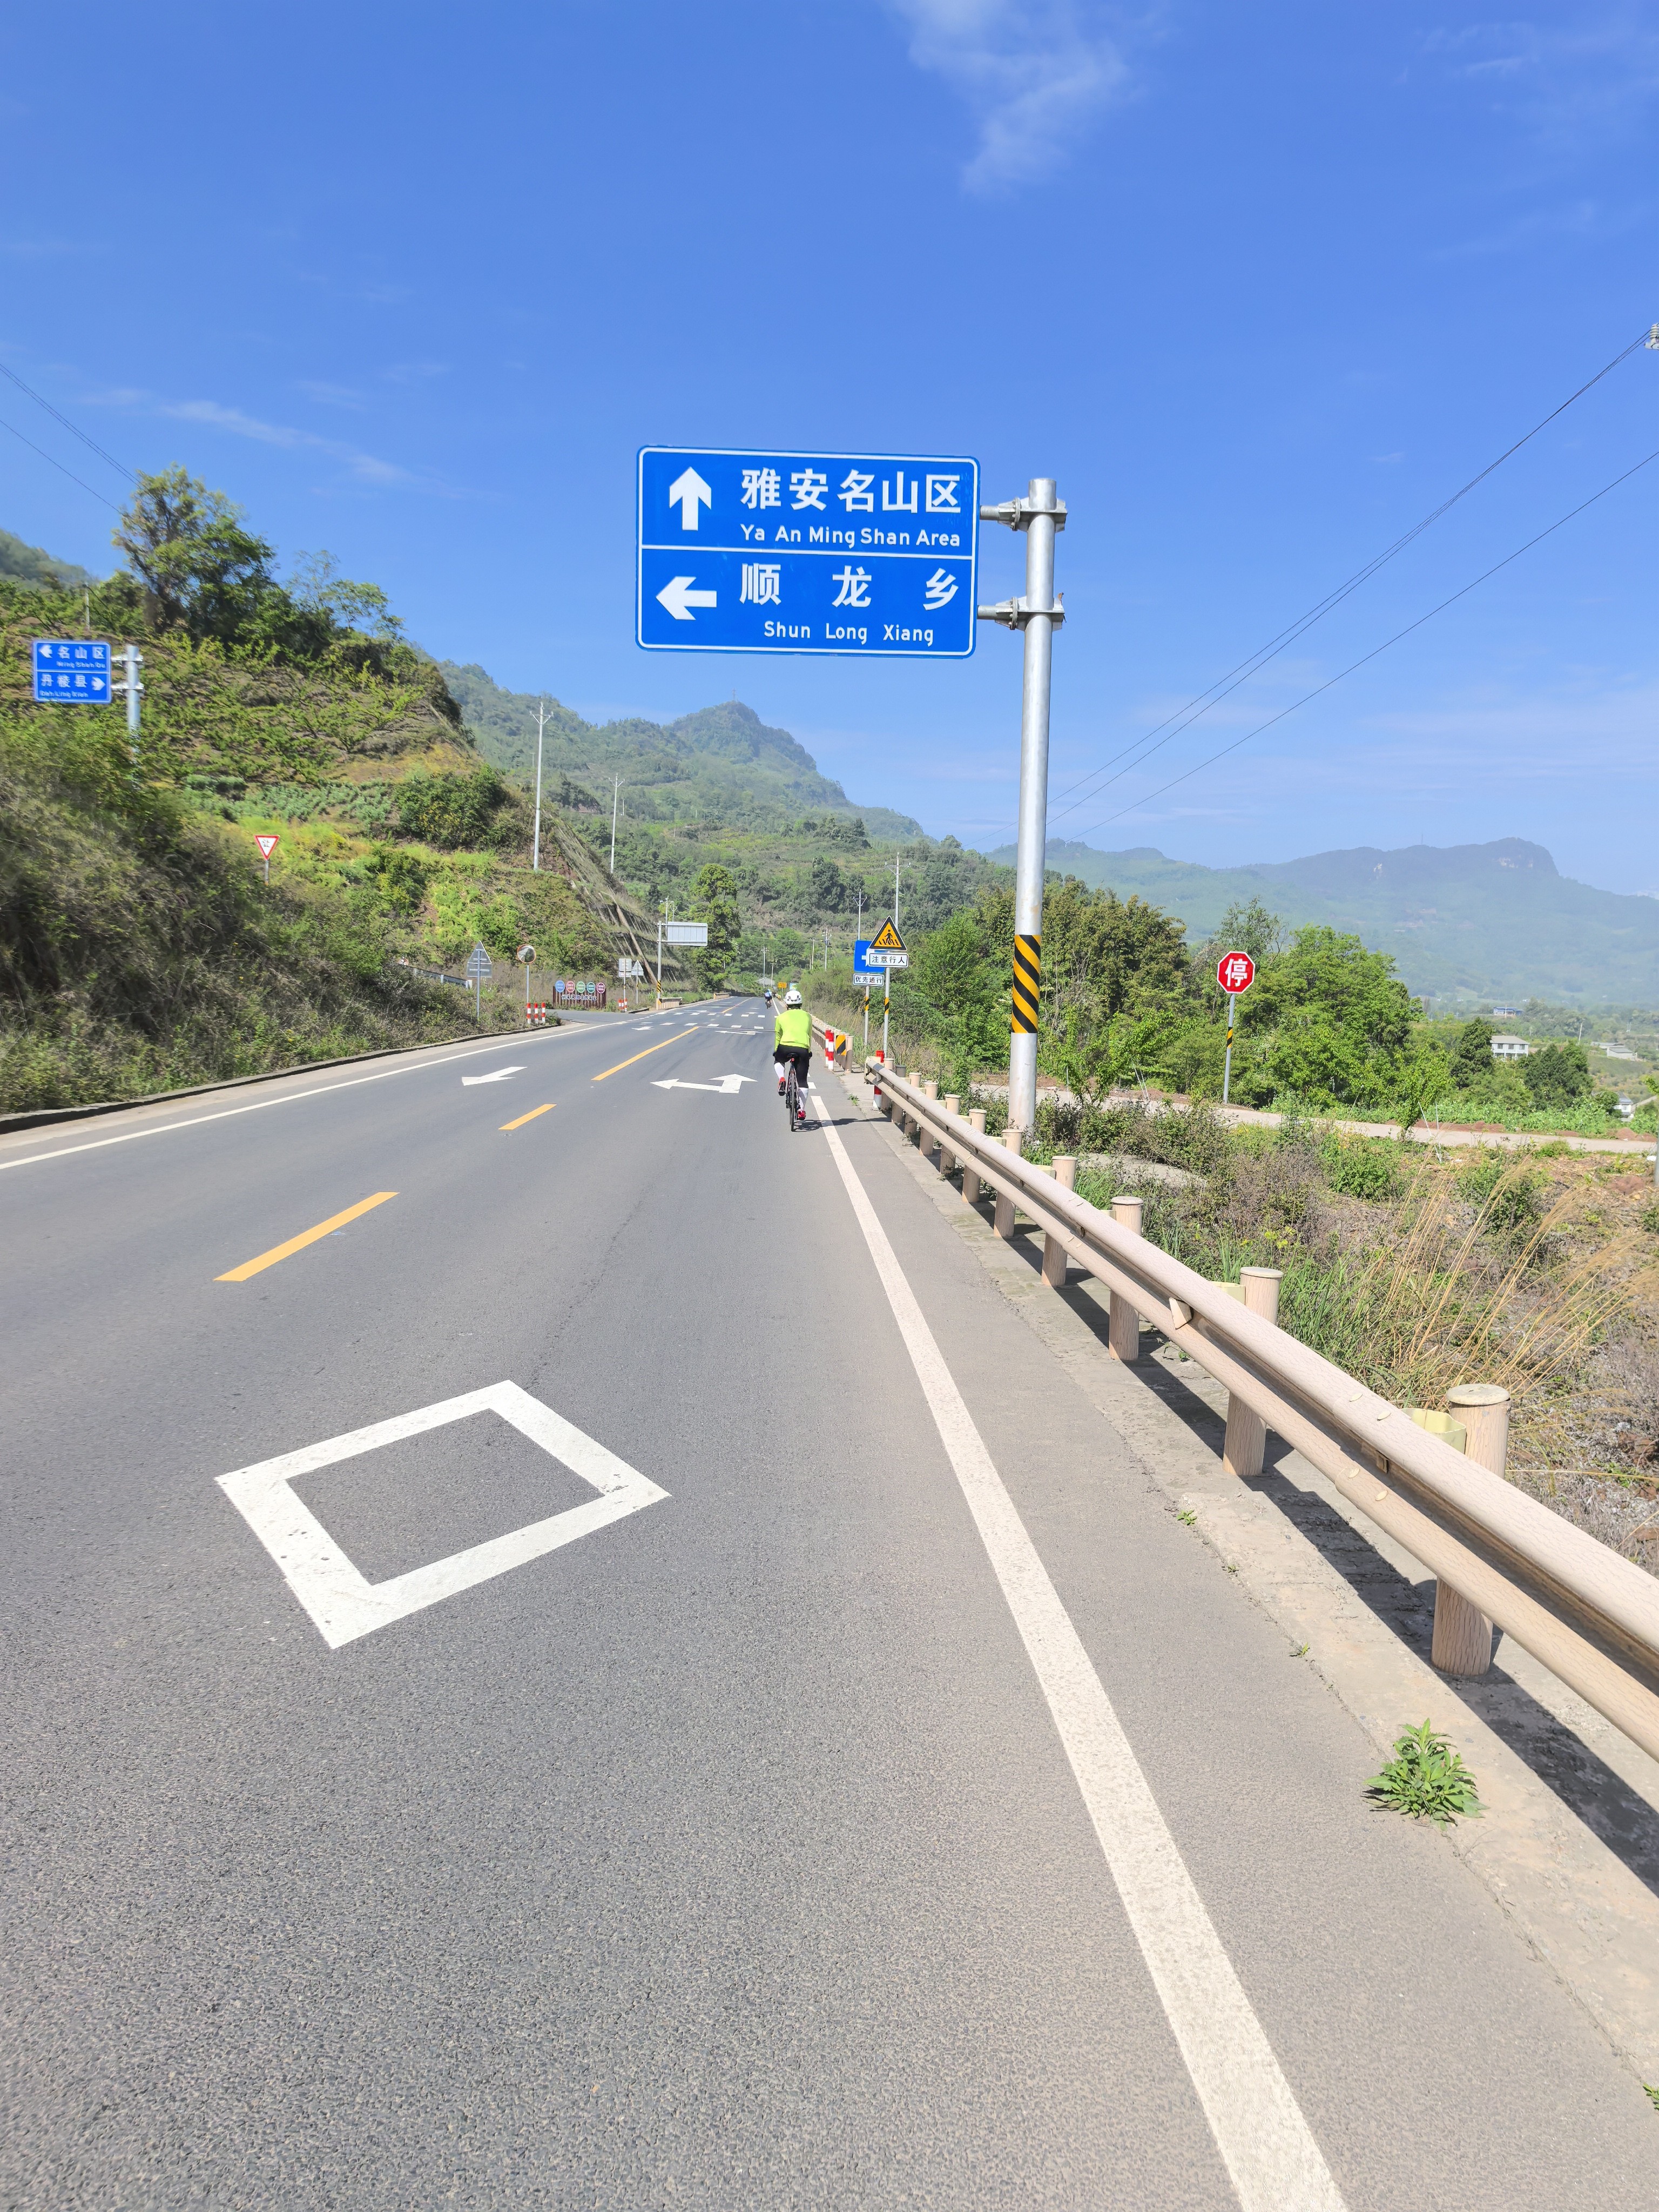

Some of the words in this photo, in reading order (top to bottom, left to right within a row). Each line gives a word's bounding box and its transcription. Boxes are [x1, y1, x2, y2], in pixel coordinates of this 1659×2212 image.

[740, 467, 961, 514] 雅安名山区
[740, 523, 765, 541] Ya
[774, 525, 801, 542] An
[809, 526, 855, 549] Ming
[860, 527, 910, 545] Shan
[915, 529, 960, 547] Area
[739, 563, 959, 611] 顺龙乡
[764, 621, 811, 638] Shun
[826, 623, 867, 645] Long
[883, 624, 933, 647] Xiang
[57, 645, 105, 659] 名山区
[1224, 959, 1248, 987] 停
